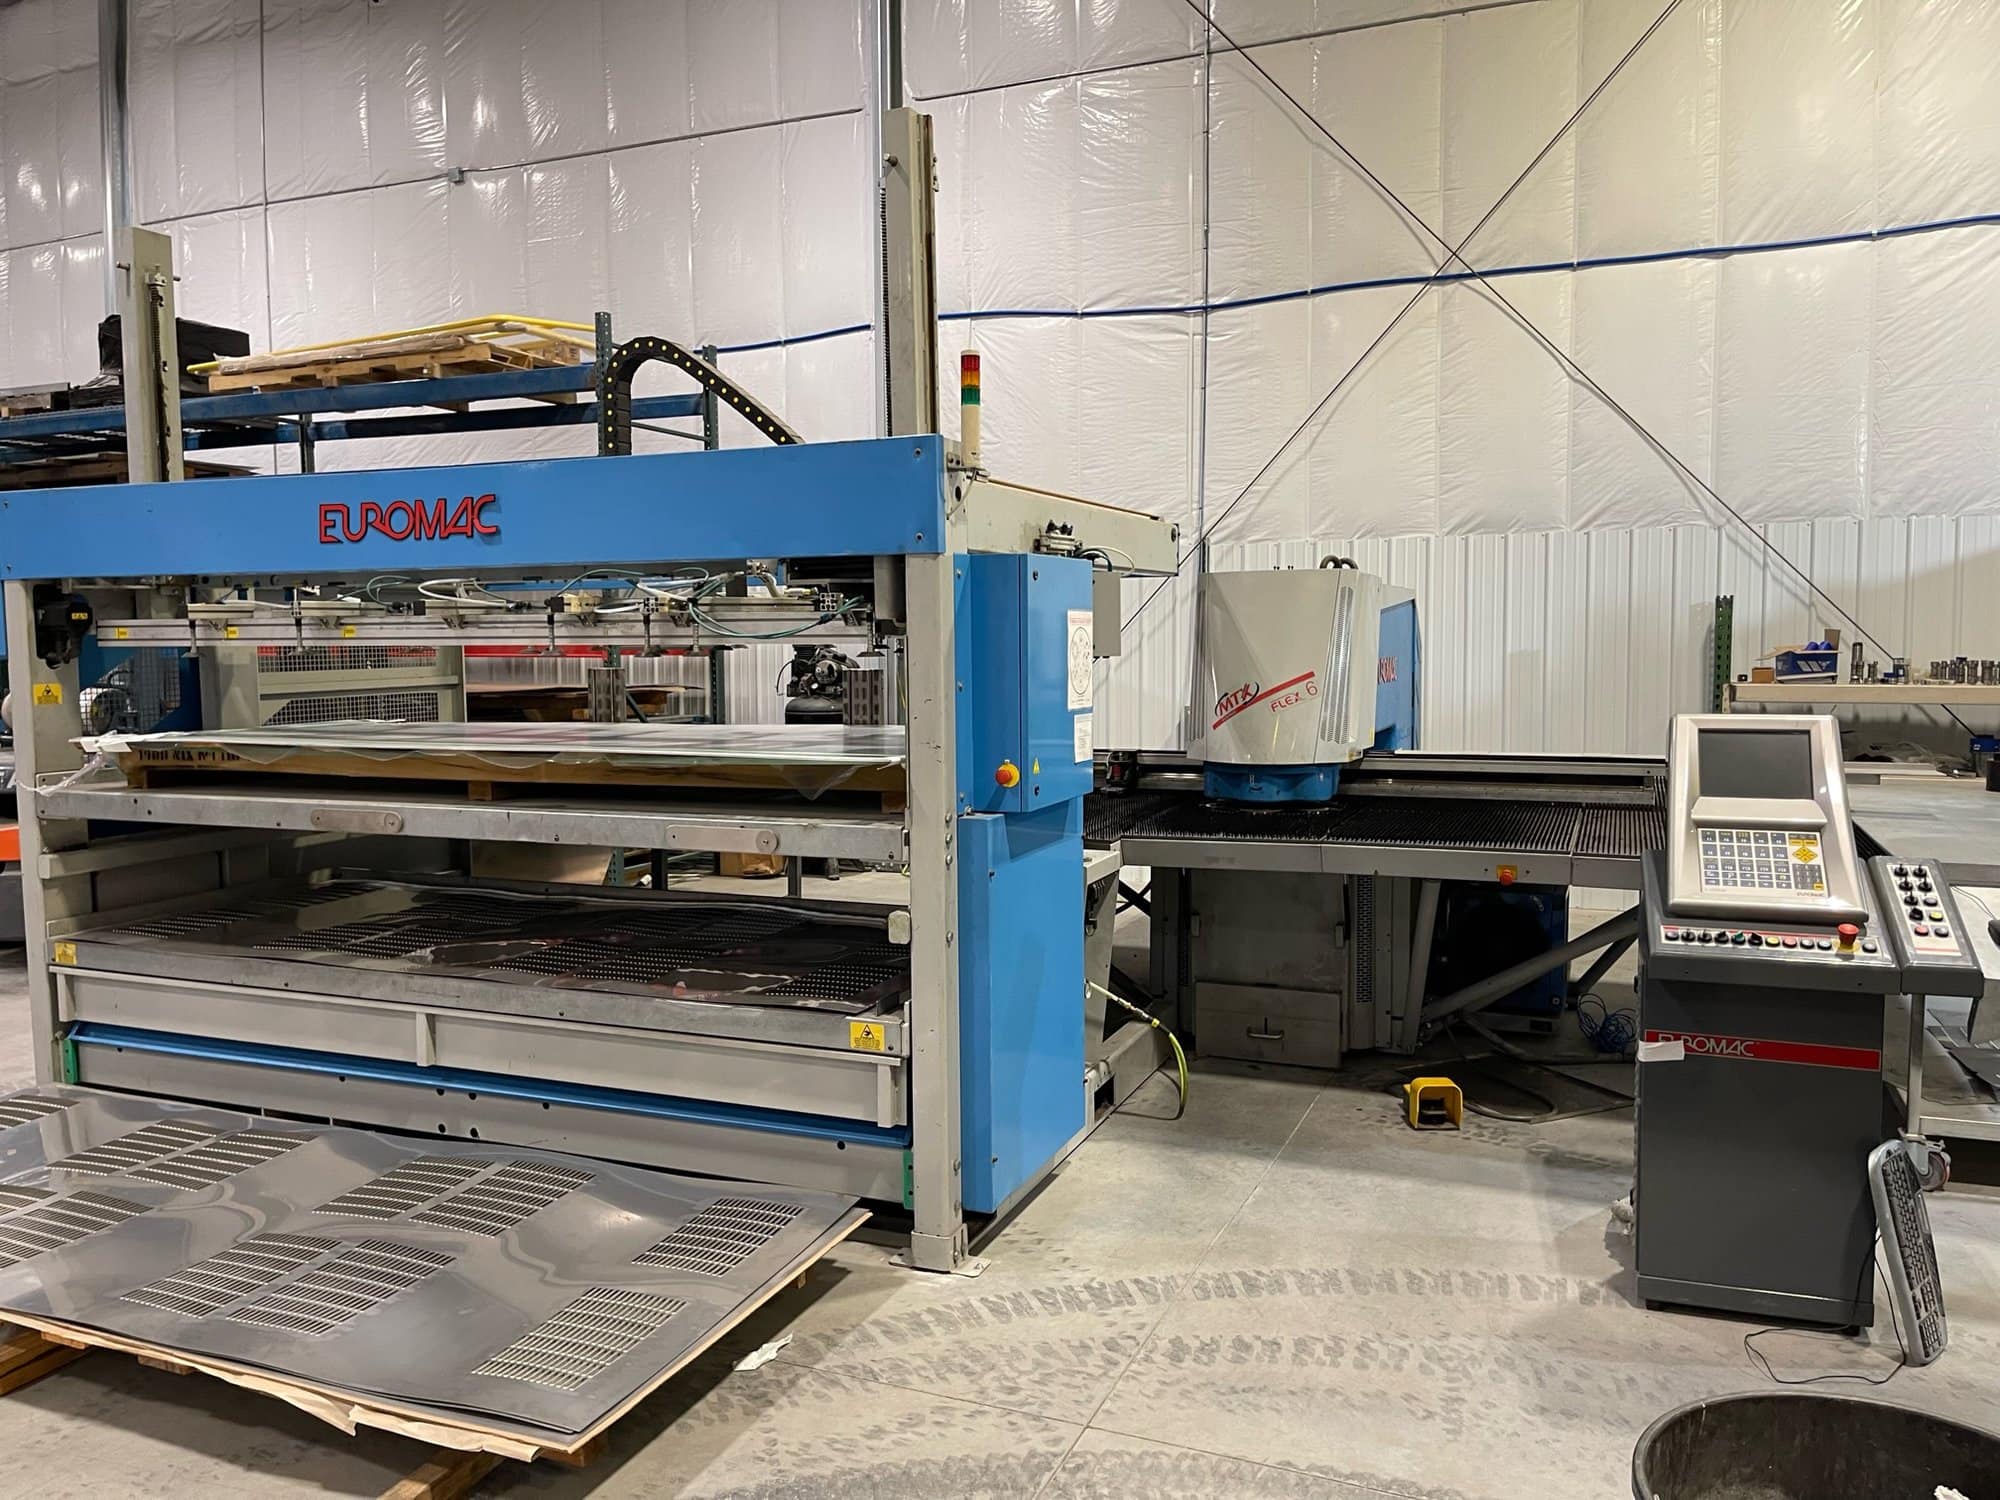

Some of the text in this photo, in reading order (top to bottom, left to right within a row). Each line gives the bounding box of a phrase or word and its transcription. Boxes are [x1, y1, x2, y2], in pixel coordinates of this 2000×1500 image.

[319, 494, 498, 543] EUROMAC
[1270, 681, 1319, 713] FLEX 6
[1658, 1033, 1755, 1057] ROMAC
